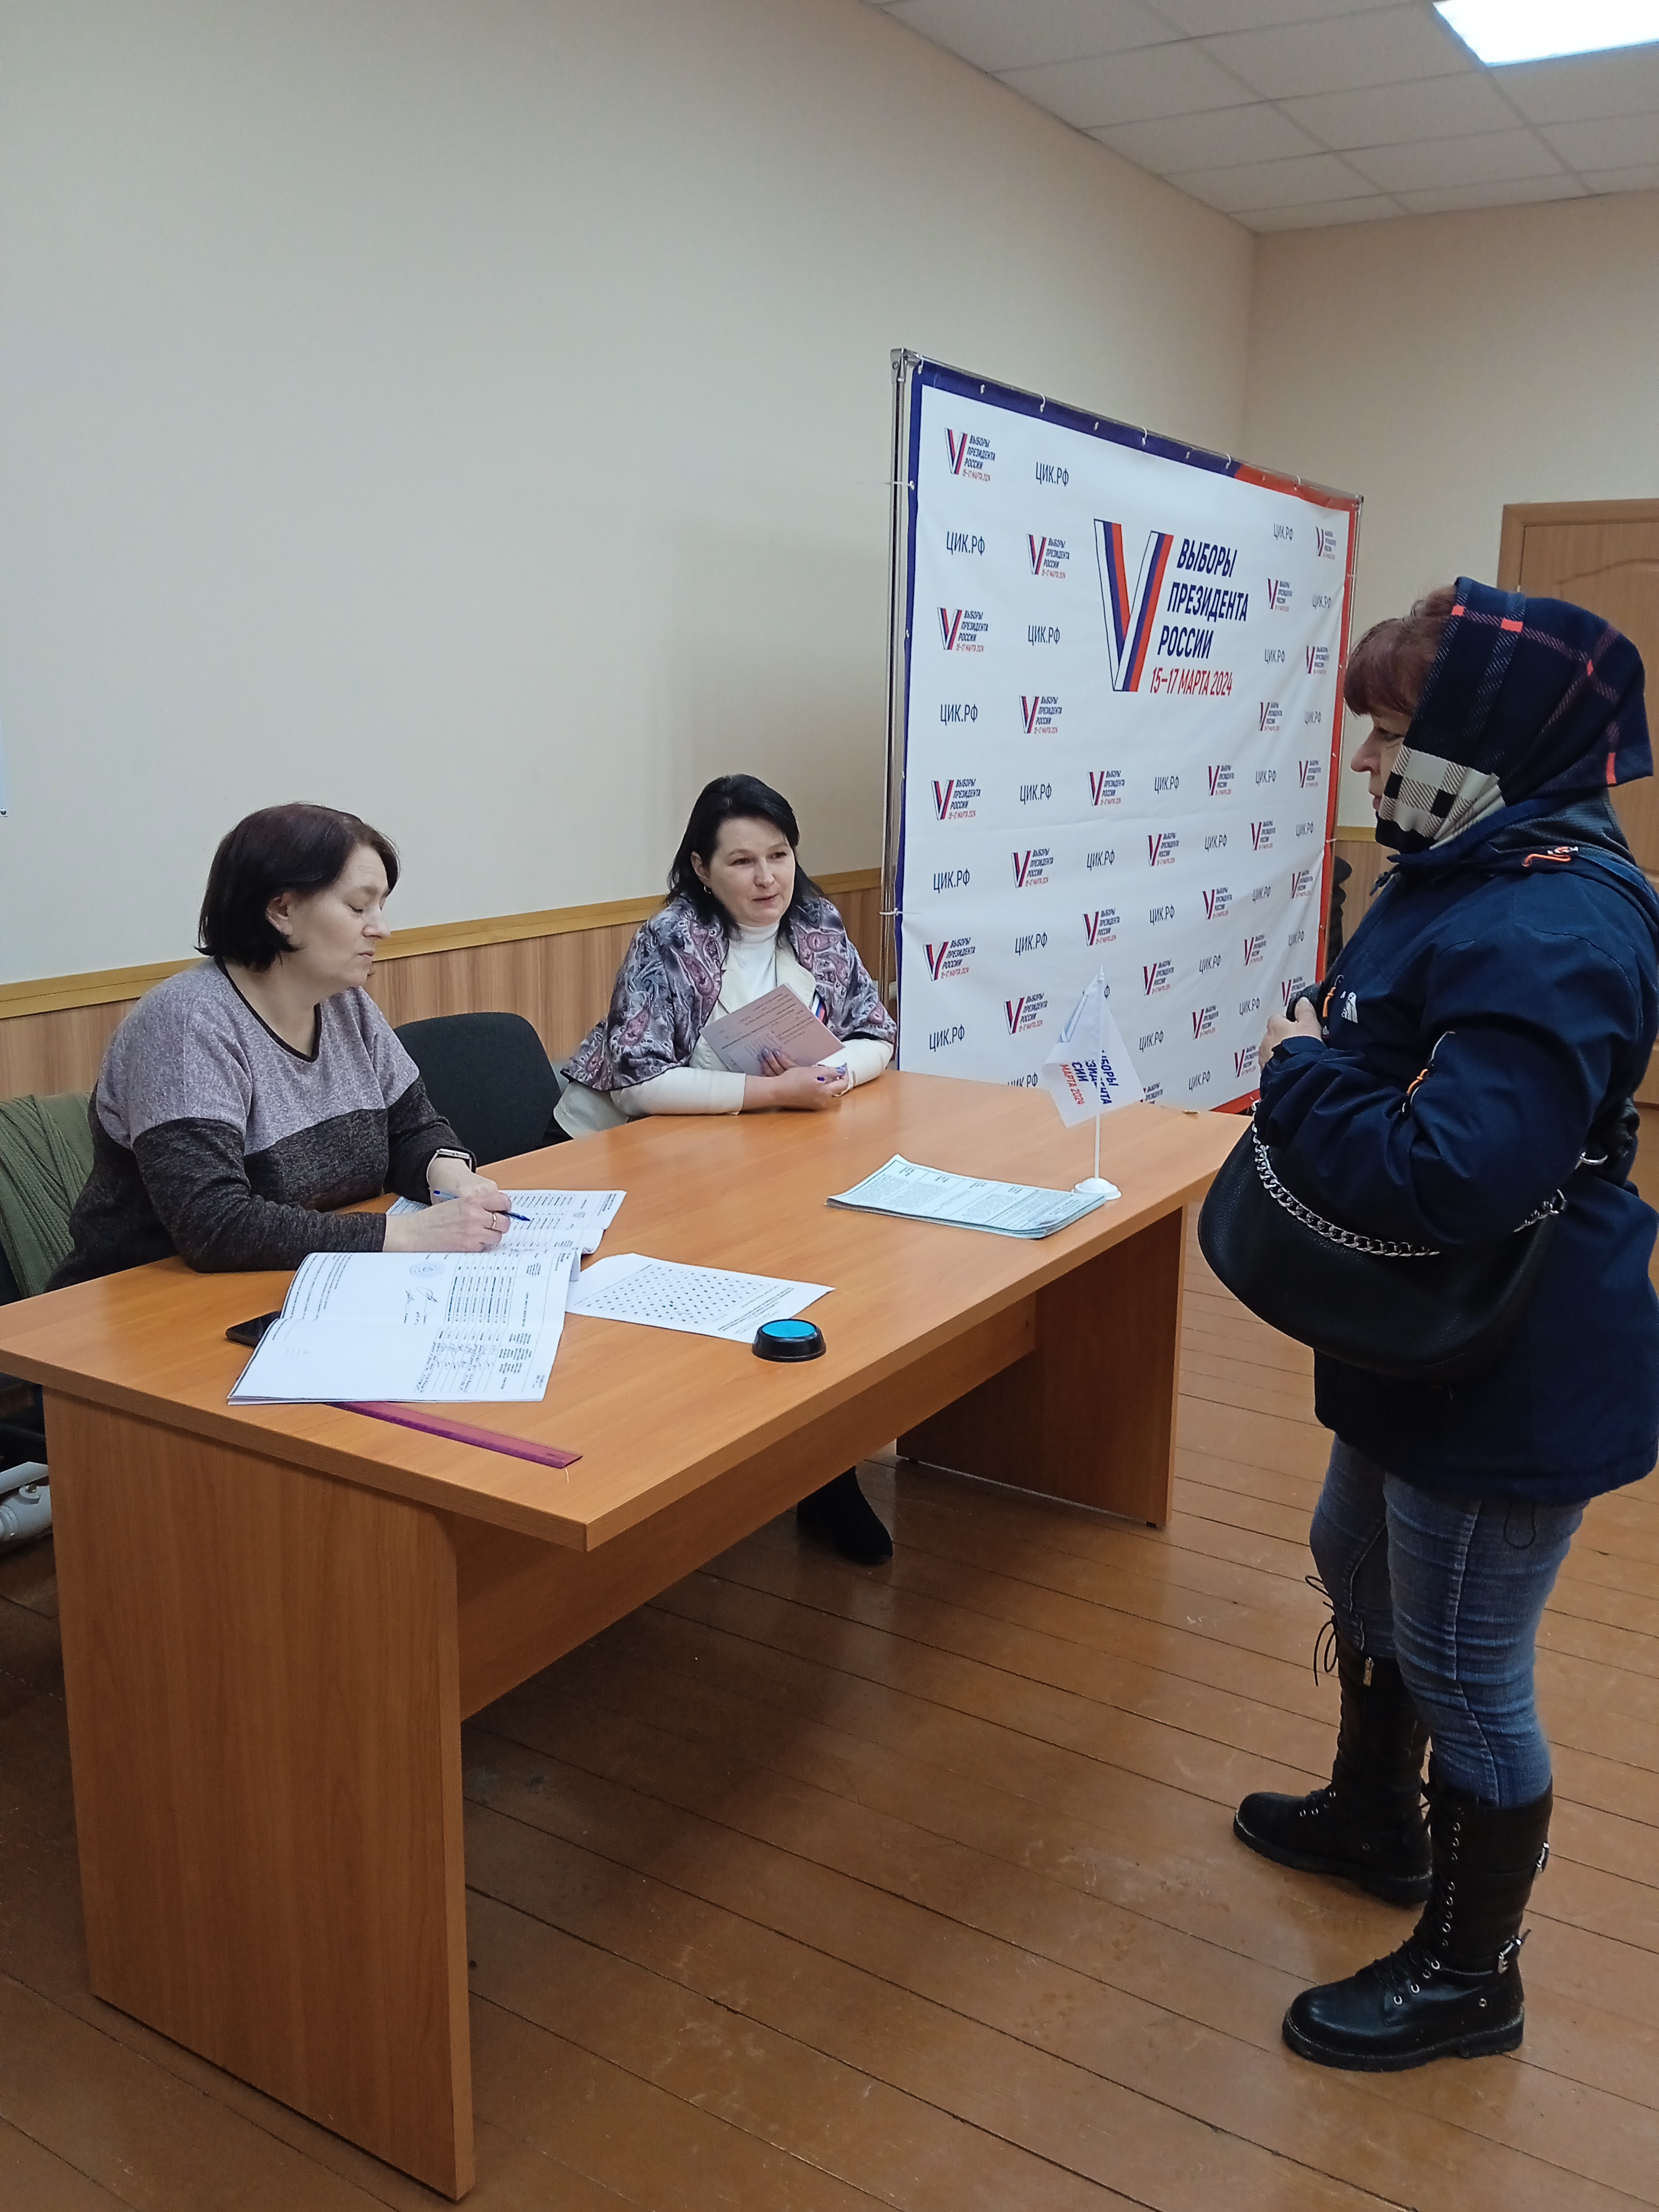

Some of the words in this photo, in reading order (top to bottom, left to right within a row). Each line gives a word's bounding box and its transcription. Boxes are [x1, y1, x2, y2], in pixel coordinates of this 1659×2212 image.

[1036, 462, 1069, 487] ЦИК.РФ
[946, 531, 985, 555] ЦИК.РФ
[1176, 538, 1238, 578] ВЫБОРЫ
[1167, 581, 1249, 622] ПРЕЗИДЕНТА
[1028, 625, 1060, 645] ЦИК.РФ
[1157, 625, 1214, 659] РОССИИ
[1177, 668, 1211, 696] МАРТА
[1210, 671, 1233, 697] 2024
[941, 704, 977, 726] ЦИК.РФ
[1020, 783, 1051, 805] ЦИК.РФ
[1154, 776, 1179, 794] ЦИК.РФ
[1205, 834, 1227, 852] ЦИК.РФ
[1087, 850, 1115, 871] ЦИК.РФ
[934, 869, 970, 893] ЦИК.РФ
[1150, 905, 1175, 925] ЦИК.РФ
[1015, 932, 1047, 956] ЦИК.РФ
[1239, 997, 1260, 1017] ЦИК.РФ
[929, 1025, 965, 1052] ЦИК.РФ
[1139, 1030, 1163, 1052] ЦИК.РФ
[1189, 1070, 1211, 1092] ЦИК.РФ
